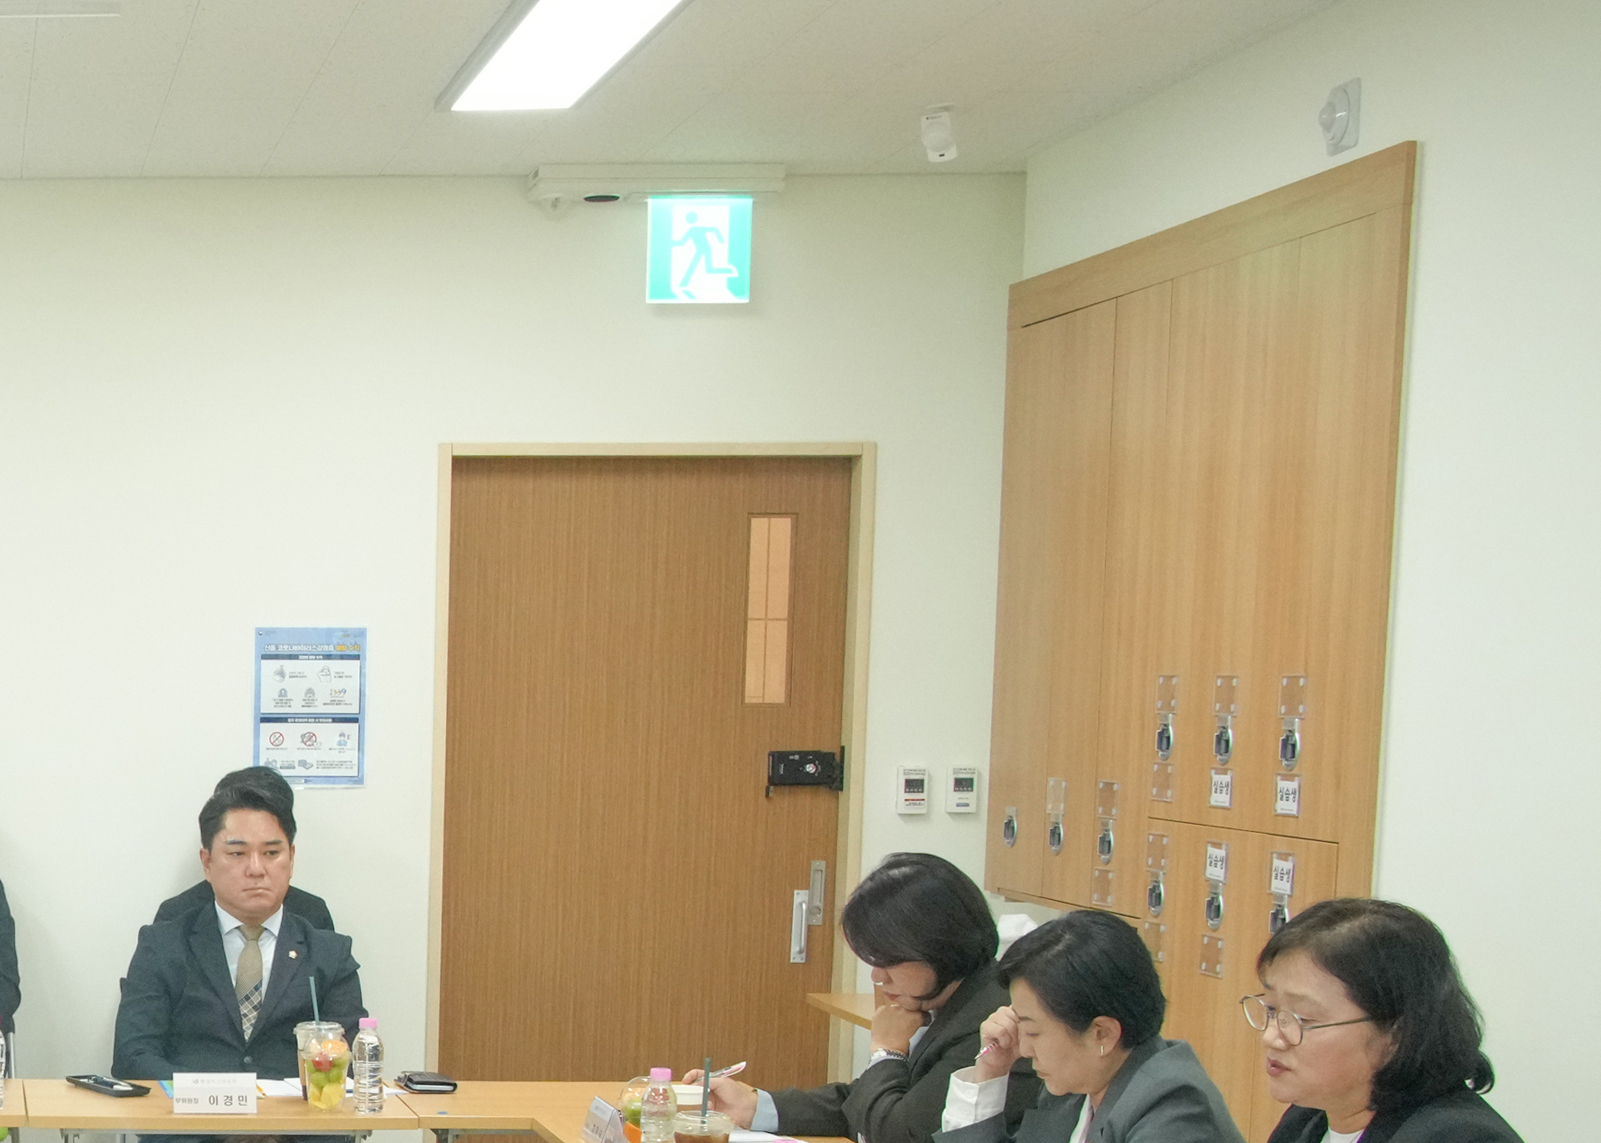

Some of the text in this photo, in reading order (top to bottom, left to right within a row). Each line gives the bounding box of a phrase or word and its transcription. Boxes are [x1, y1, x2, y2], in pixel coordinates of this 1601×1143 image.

[1213, 780, 1230, 795] 실습생
[1279, 787, 1297, 803] 실습생
[1208, 853, 1225, 870] 실습생
[1273, 865, 1291, 883] 실습생
[208, 1095, 248, 1106] 이경민
